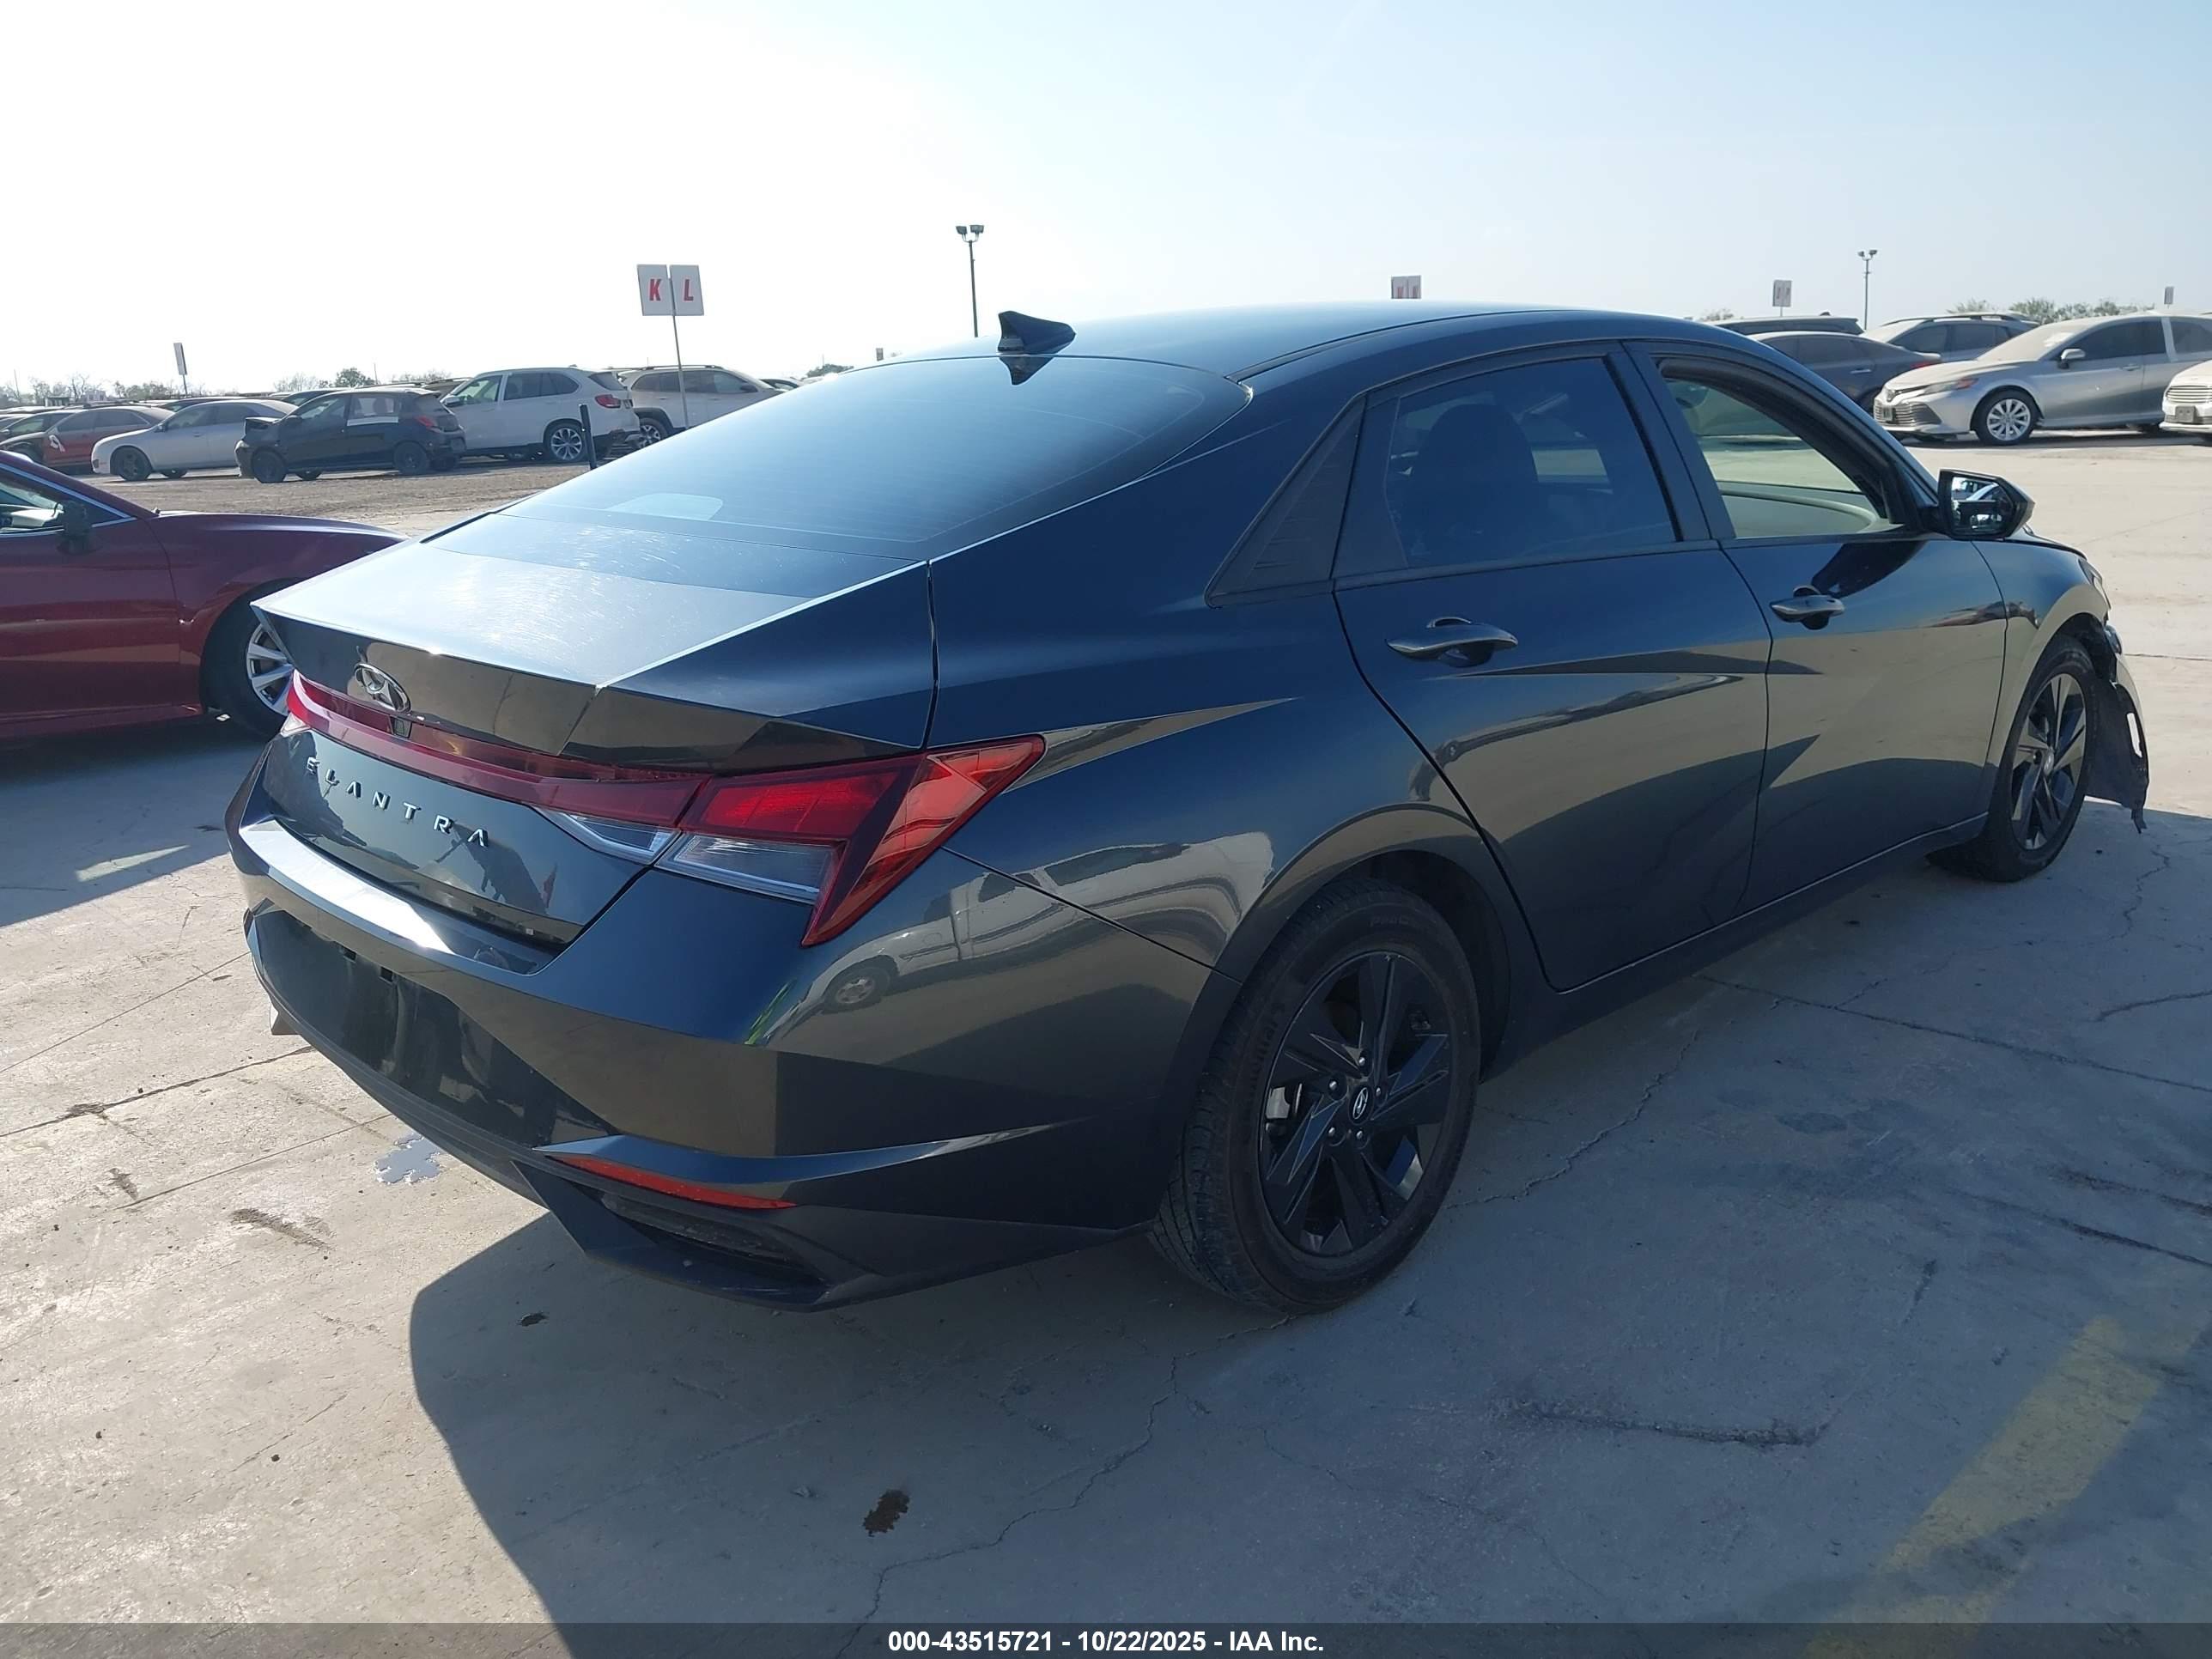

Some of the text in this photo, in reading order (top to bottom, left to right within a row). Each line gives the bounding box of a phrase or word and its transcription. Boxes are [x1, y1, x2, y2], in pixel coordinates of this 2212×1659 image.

[649, 278, 662, 301] K
[684, 278, 694, 301] L
[307, 757, 488, 847] ELANTRA
